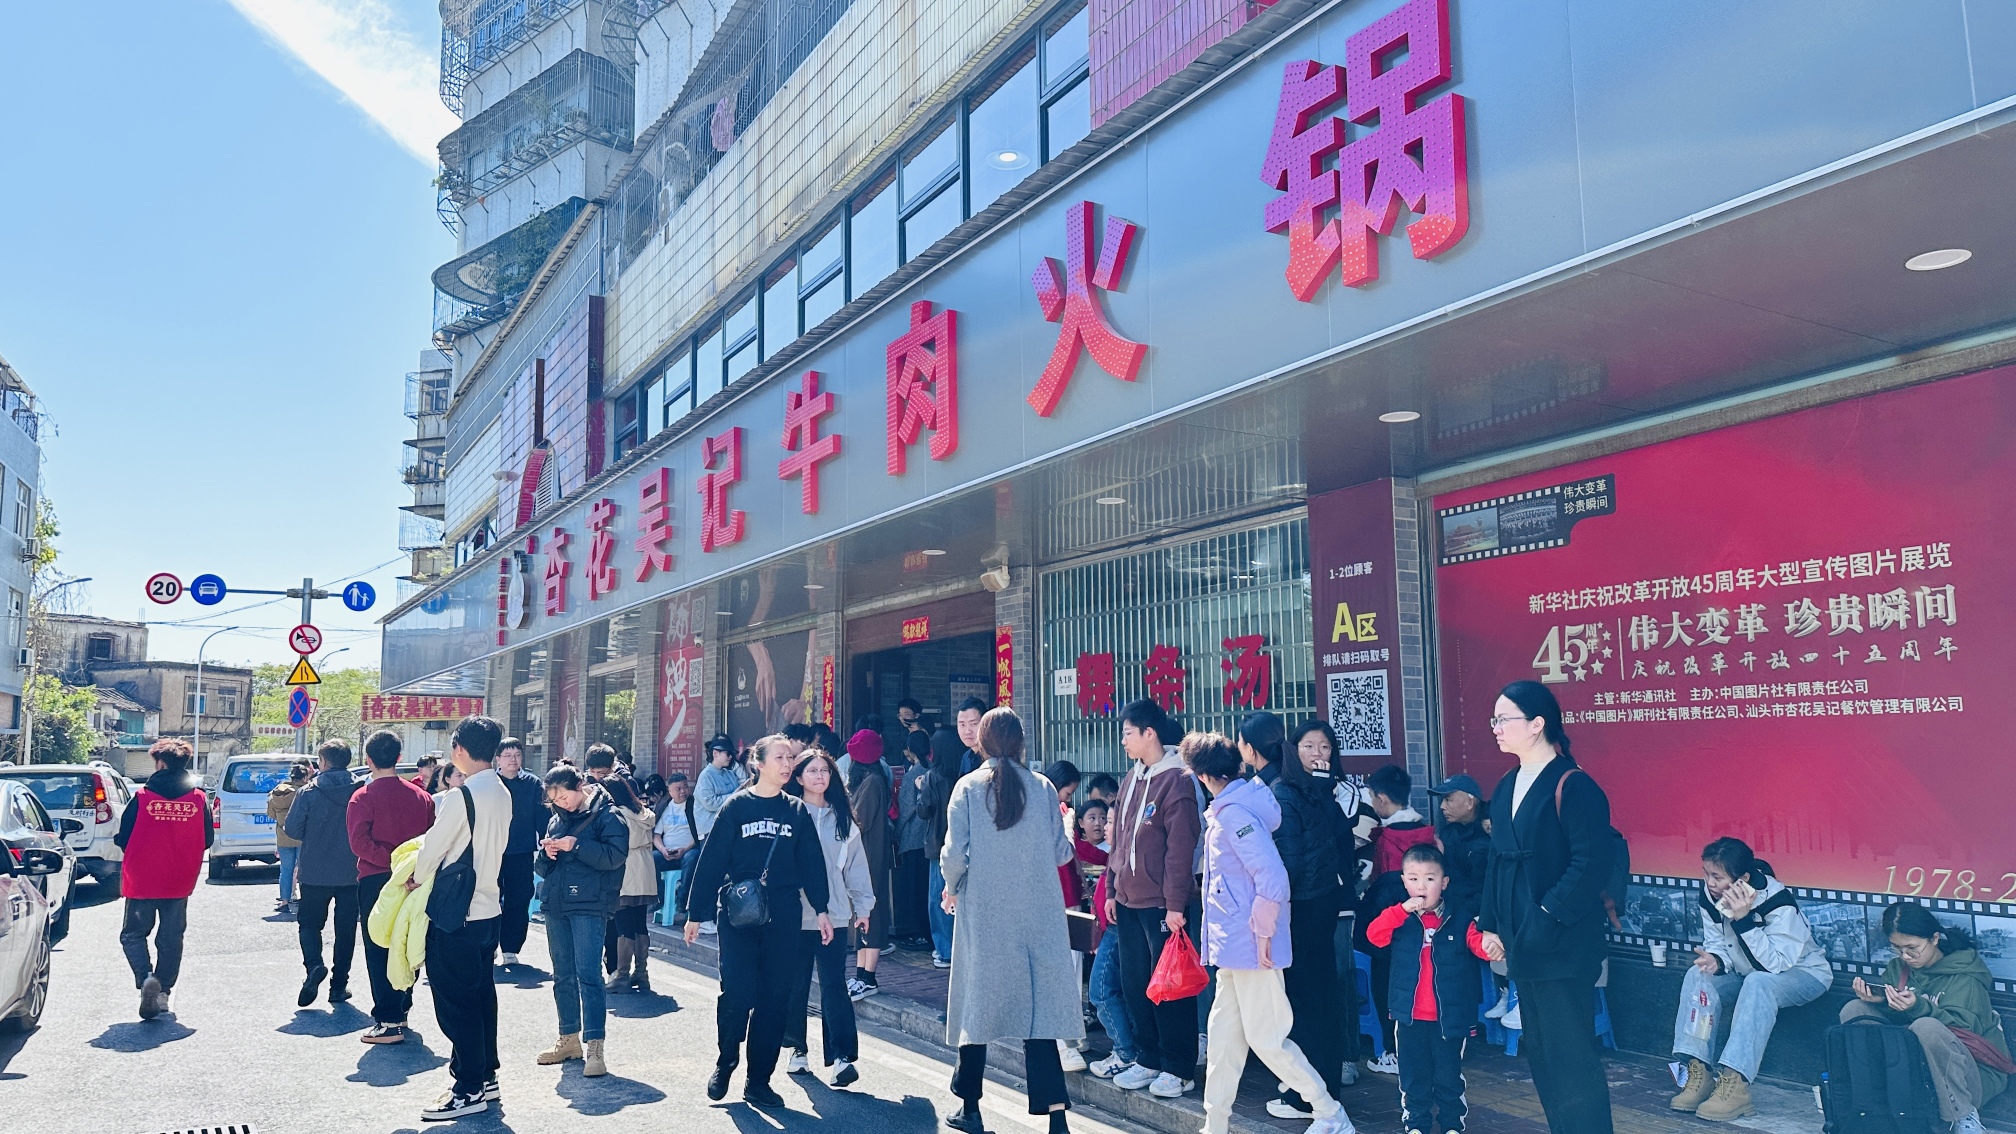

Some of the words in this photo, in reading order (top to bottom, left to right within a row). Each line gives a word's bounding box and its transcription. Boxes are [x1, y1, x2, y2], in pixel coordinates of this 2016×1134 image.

[544, 0, 1465, 616] 杏花吴记牛肉火锅
[1563, 479, 1607, 499] 伟大变革
[1564, 495, 1608, 514] 珍贵瞬间
[152, 581, 177, 596] 20
[1329, 561, 1373, 579] 1-2位顾客
[1529, 542, 1953, 614] 新华社庆祝改革开放45周年大型宣传图片展览
[1331, 602, 1378, 643] A区
[1627, 603, 1769, 651] 伟大变革
[1783, 583, 1957, 638] 珍贵瞬间
[1322, 648, 1390, 667] 排队请扫码取号
[1532, 624, 1588, 684] 45
[1632, 636, 1958, 679] 庆祝改革开放四十五周年
